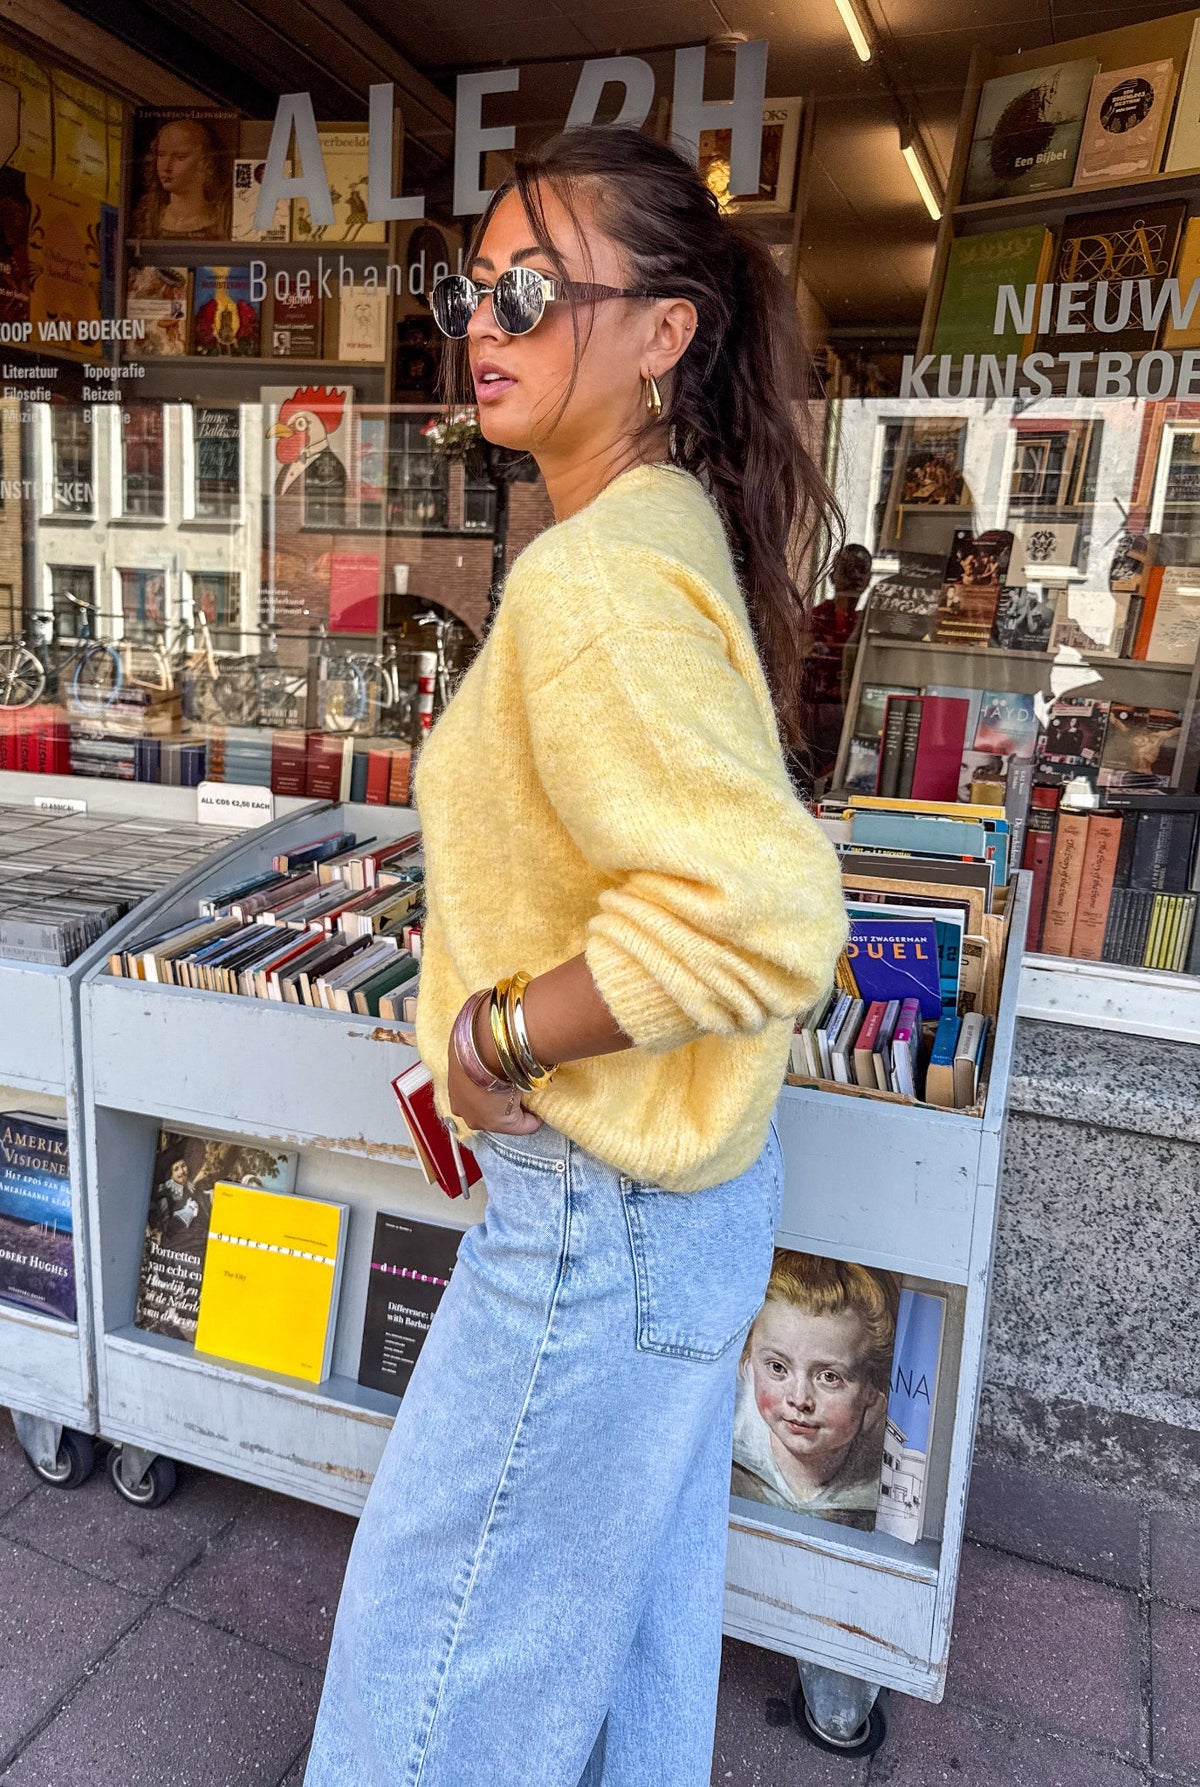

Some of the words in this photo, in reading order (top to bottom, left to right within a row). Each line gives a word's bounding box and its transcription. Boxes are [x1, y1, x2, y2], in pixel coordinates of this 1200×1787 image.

[253, 40, 769, 230] ALEPH
[1014, 157, 1034, 168] Een
[1035, 149, 1067, 165] Bijbel
[249, 248, 464, 302] Boekhandel
[993, 277, 1200, 335] NIEUW
[0, 321, 33, 342] OOP
[37, 321, 72, 342] VAN
[78, 318, 146, 341] BOEKEN
[2, 364, 59, 379] Literatuur
[83, 363, 146, 381] Topografie
[901, 350, 1200, 403] KUNSTBOE
[4, 386, 52, 401] Filosofie
[83, 386, 122, 401] Reizen
[980, 705, 1036, 723] HAYD
[201, 797, 214, 805] ALL
[215, 798, 230, 806] CDS
[251, 802, 270, 810] EACH
[847, 942, 929, 960] DUEL
[150, 1241, 201, 1265] Portretten
[217, 1231, 327, 1264] differences
[29, 1254, 69, 1277] HUGHES
[148, 1260, 166, 1273] van
[167, 1264, 188, 1278] echt
[189, 1271, 203, 1281] en
[155, 1292, 167, 1304] de
[386, 1313, 404, 1325] with
[387, 1301, 430, 1320] Difference:
[890, 1365, 930, 1405] NA
